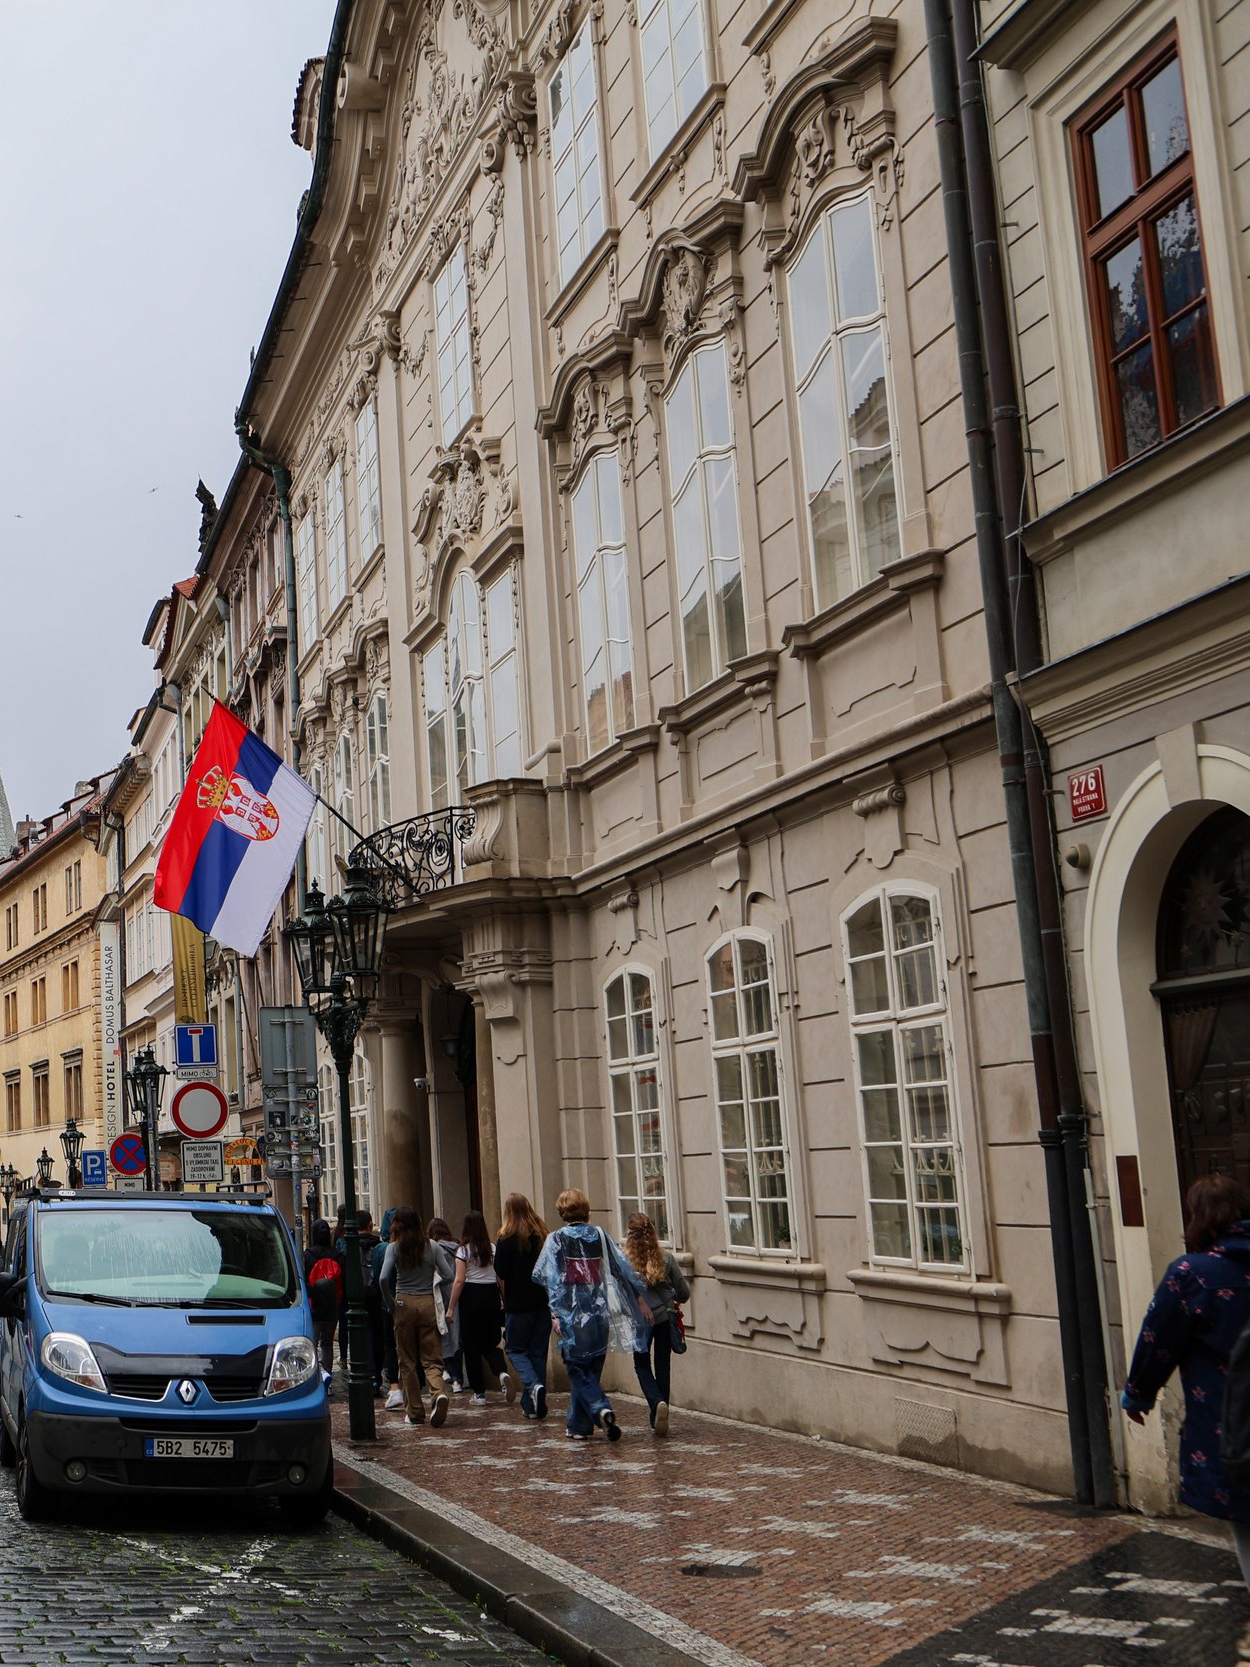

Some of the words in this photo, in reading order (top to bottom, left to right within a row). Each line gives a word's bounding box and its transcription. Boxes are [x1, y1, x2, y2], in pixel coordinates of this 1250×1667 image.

[1072, 772, 1096, 796] 276
[1073, 797, 1082, 806] MALÁ
[1082, 792, 1098, 802] STRANA
[1078, 804, 1091, 813] PRAHA
[104, 946, 114, 1001] BALTHASAR
[106, 1005, 115, 1044] DOMUS
[106, 1061, 115, 1100] HOTEL
[107, 1105, 116, 1145] DESIGN
[86, 1155, 101, 1175] P
[157, 1441, 182, 1455] 5B2
[194, 1441, 227, 1455] 5475
